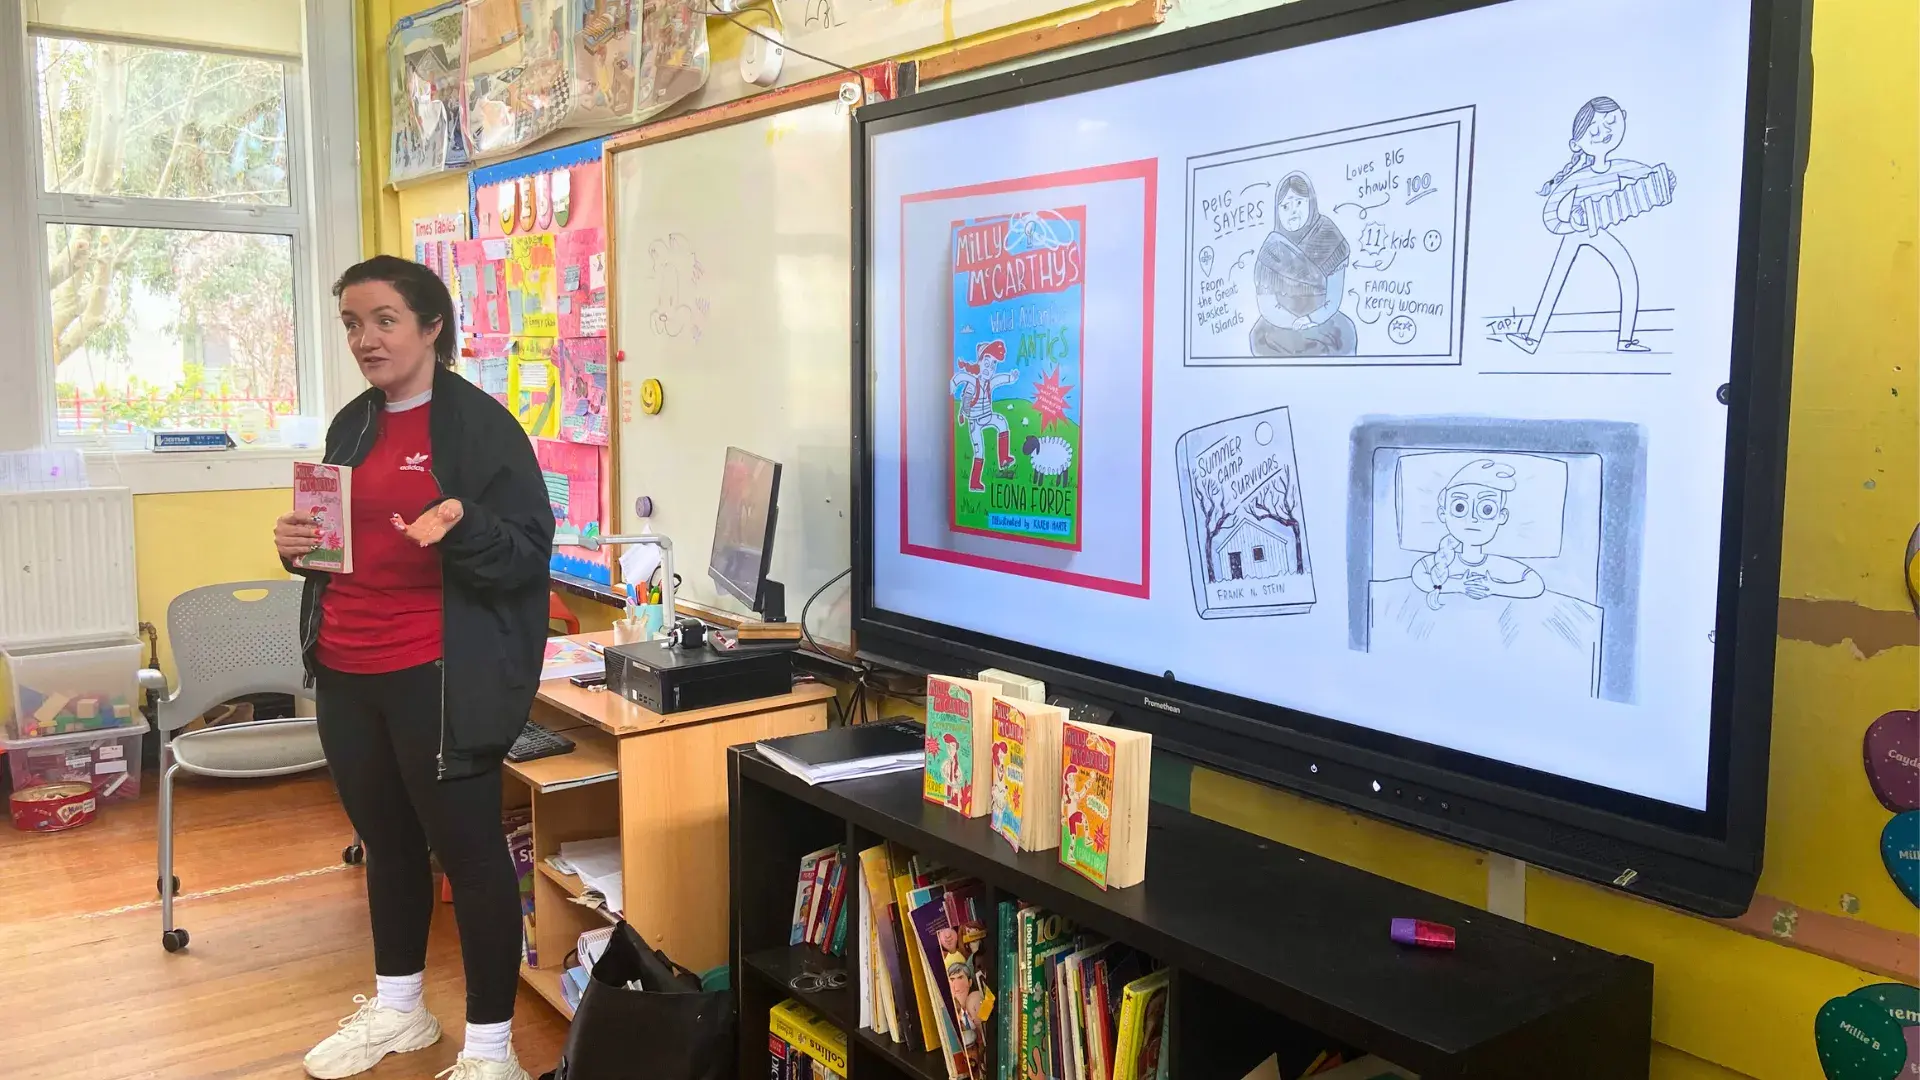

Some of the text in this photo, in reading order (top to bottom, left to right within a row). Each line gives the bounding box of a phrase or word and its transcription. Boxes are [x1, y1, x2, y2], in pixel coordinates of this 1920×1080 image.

[1384, 148, 1405, 166] BIG
[1358, 173, 1399, 199] shawls
[1213, 200, 1265, 233] SAYERS
[1364, 228, 1416, 249] 11 kids
[1197, 280, 1239, 308] the Great
[1364, 280, 1413, 295] FAMOUS
[1211, 309, 1244, 335] Islands
[399, 464, 425, 472] adidas
[1198, 435, 1242, 478] SUMMER
[1217, 456, 1243, 484] CAMP
[1230, 453, 1279, 500] SURVIVORS
[990, 482, 1072, 517] LEONA FORDE
[1216, 588, 1245, 601] FRANK
[1263, 583, 1286, 596] STEIN
[1144, 696, 1181, 714] Promethean
[1840, 1020, 1881, 1051] Millie B
[809, 1039, 845, 1069] Collins
